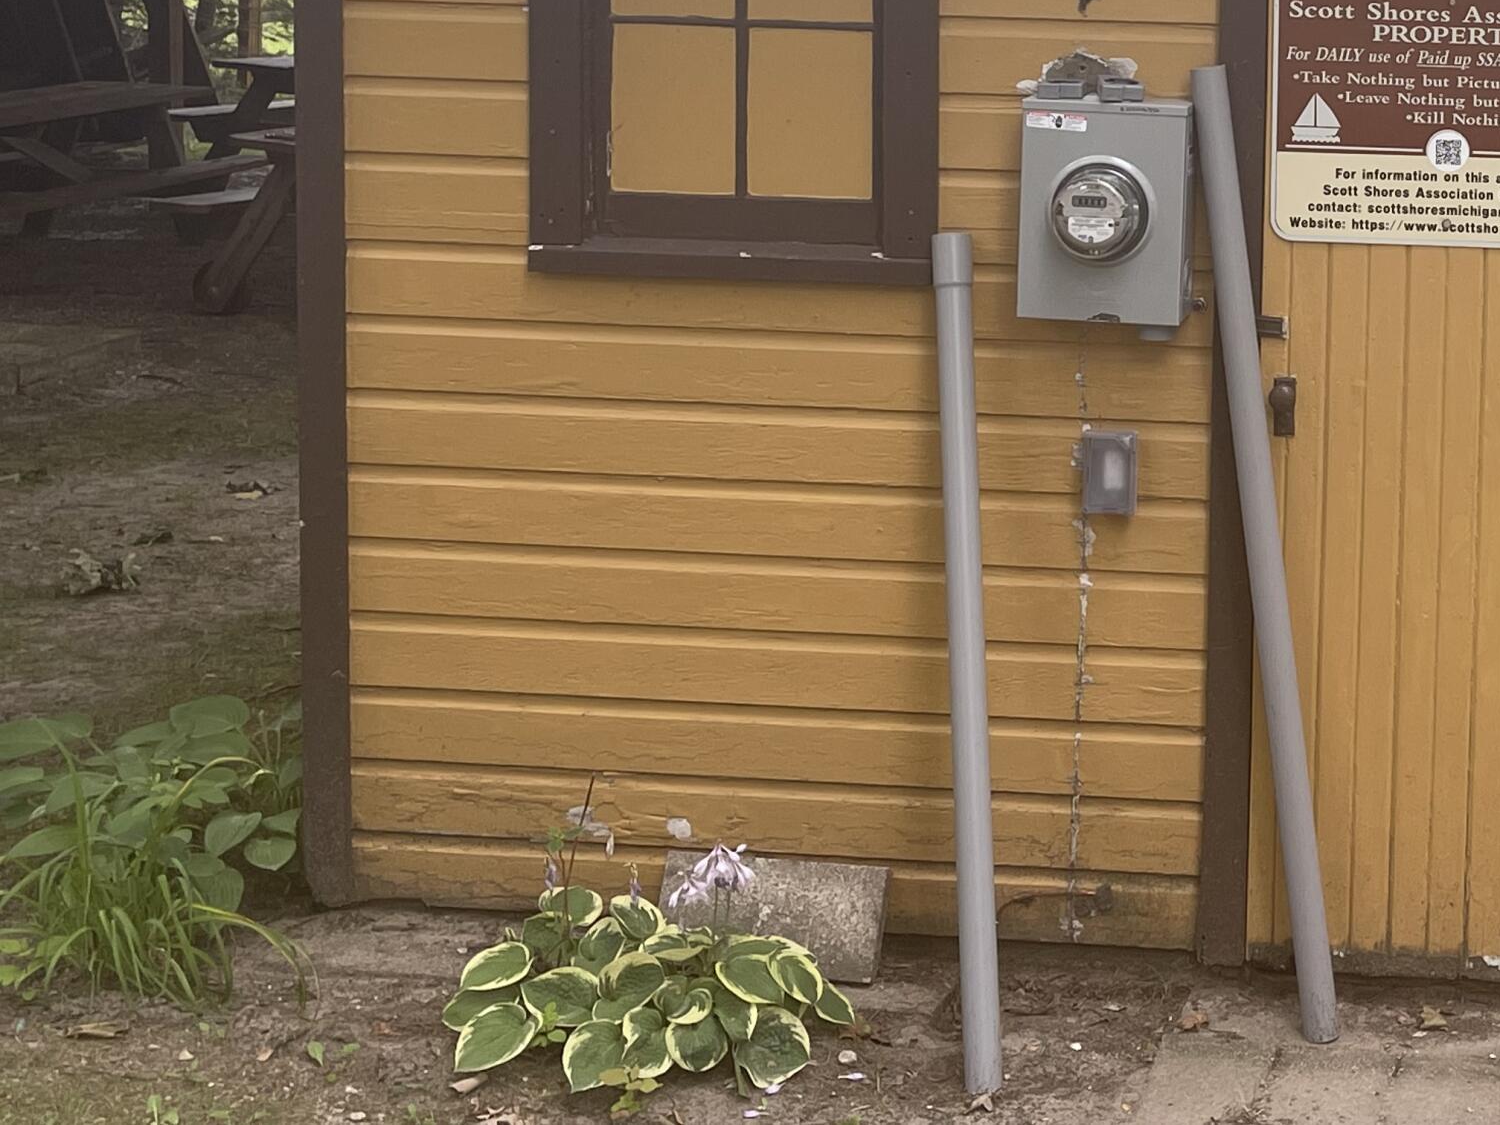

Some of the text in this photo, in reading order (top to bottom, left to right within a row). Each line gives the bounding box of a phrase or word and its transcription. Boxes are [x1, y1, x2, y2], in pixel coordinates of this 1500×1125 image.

[1289, 0, 1355, 19] Scott
[1367, 1, 1450, 23] Shores
[1286, 46, 1311, 60] For
[1315, 46, 1365, 62] DAILY
[1368, 52, 1391, 63] use
[1395, 48, 1415, 64] of
[1417, 50, 1449, 65] Paid
[1454, 55, 1472, 70] up
[1346, 72, 1416, 90] Nothing
[1422, 74, 1449, 88] but
[1397, 92, 1466, 110] Nothing
[1473, 94, 1499, 108] but
[1335, 168, 1356, 179] For
[1362, 168, 1438, 182] information
[1443, 173, 1459, 183] on
[1465, 172, 1490, 183] this
[1323, 184, 1358, 196] Scott
[1364, 185, 1410, 198] Shores
[1415, 187, 1494, 201] Association
[1307, 202, 1362, 213] contact:
[1289, 216, 1346, 229] Website:
